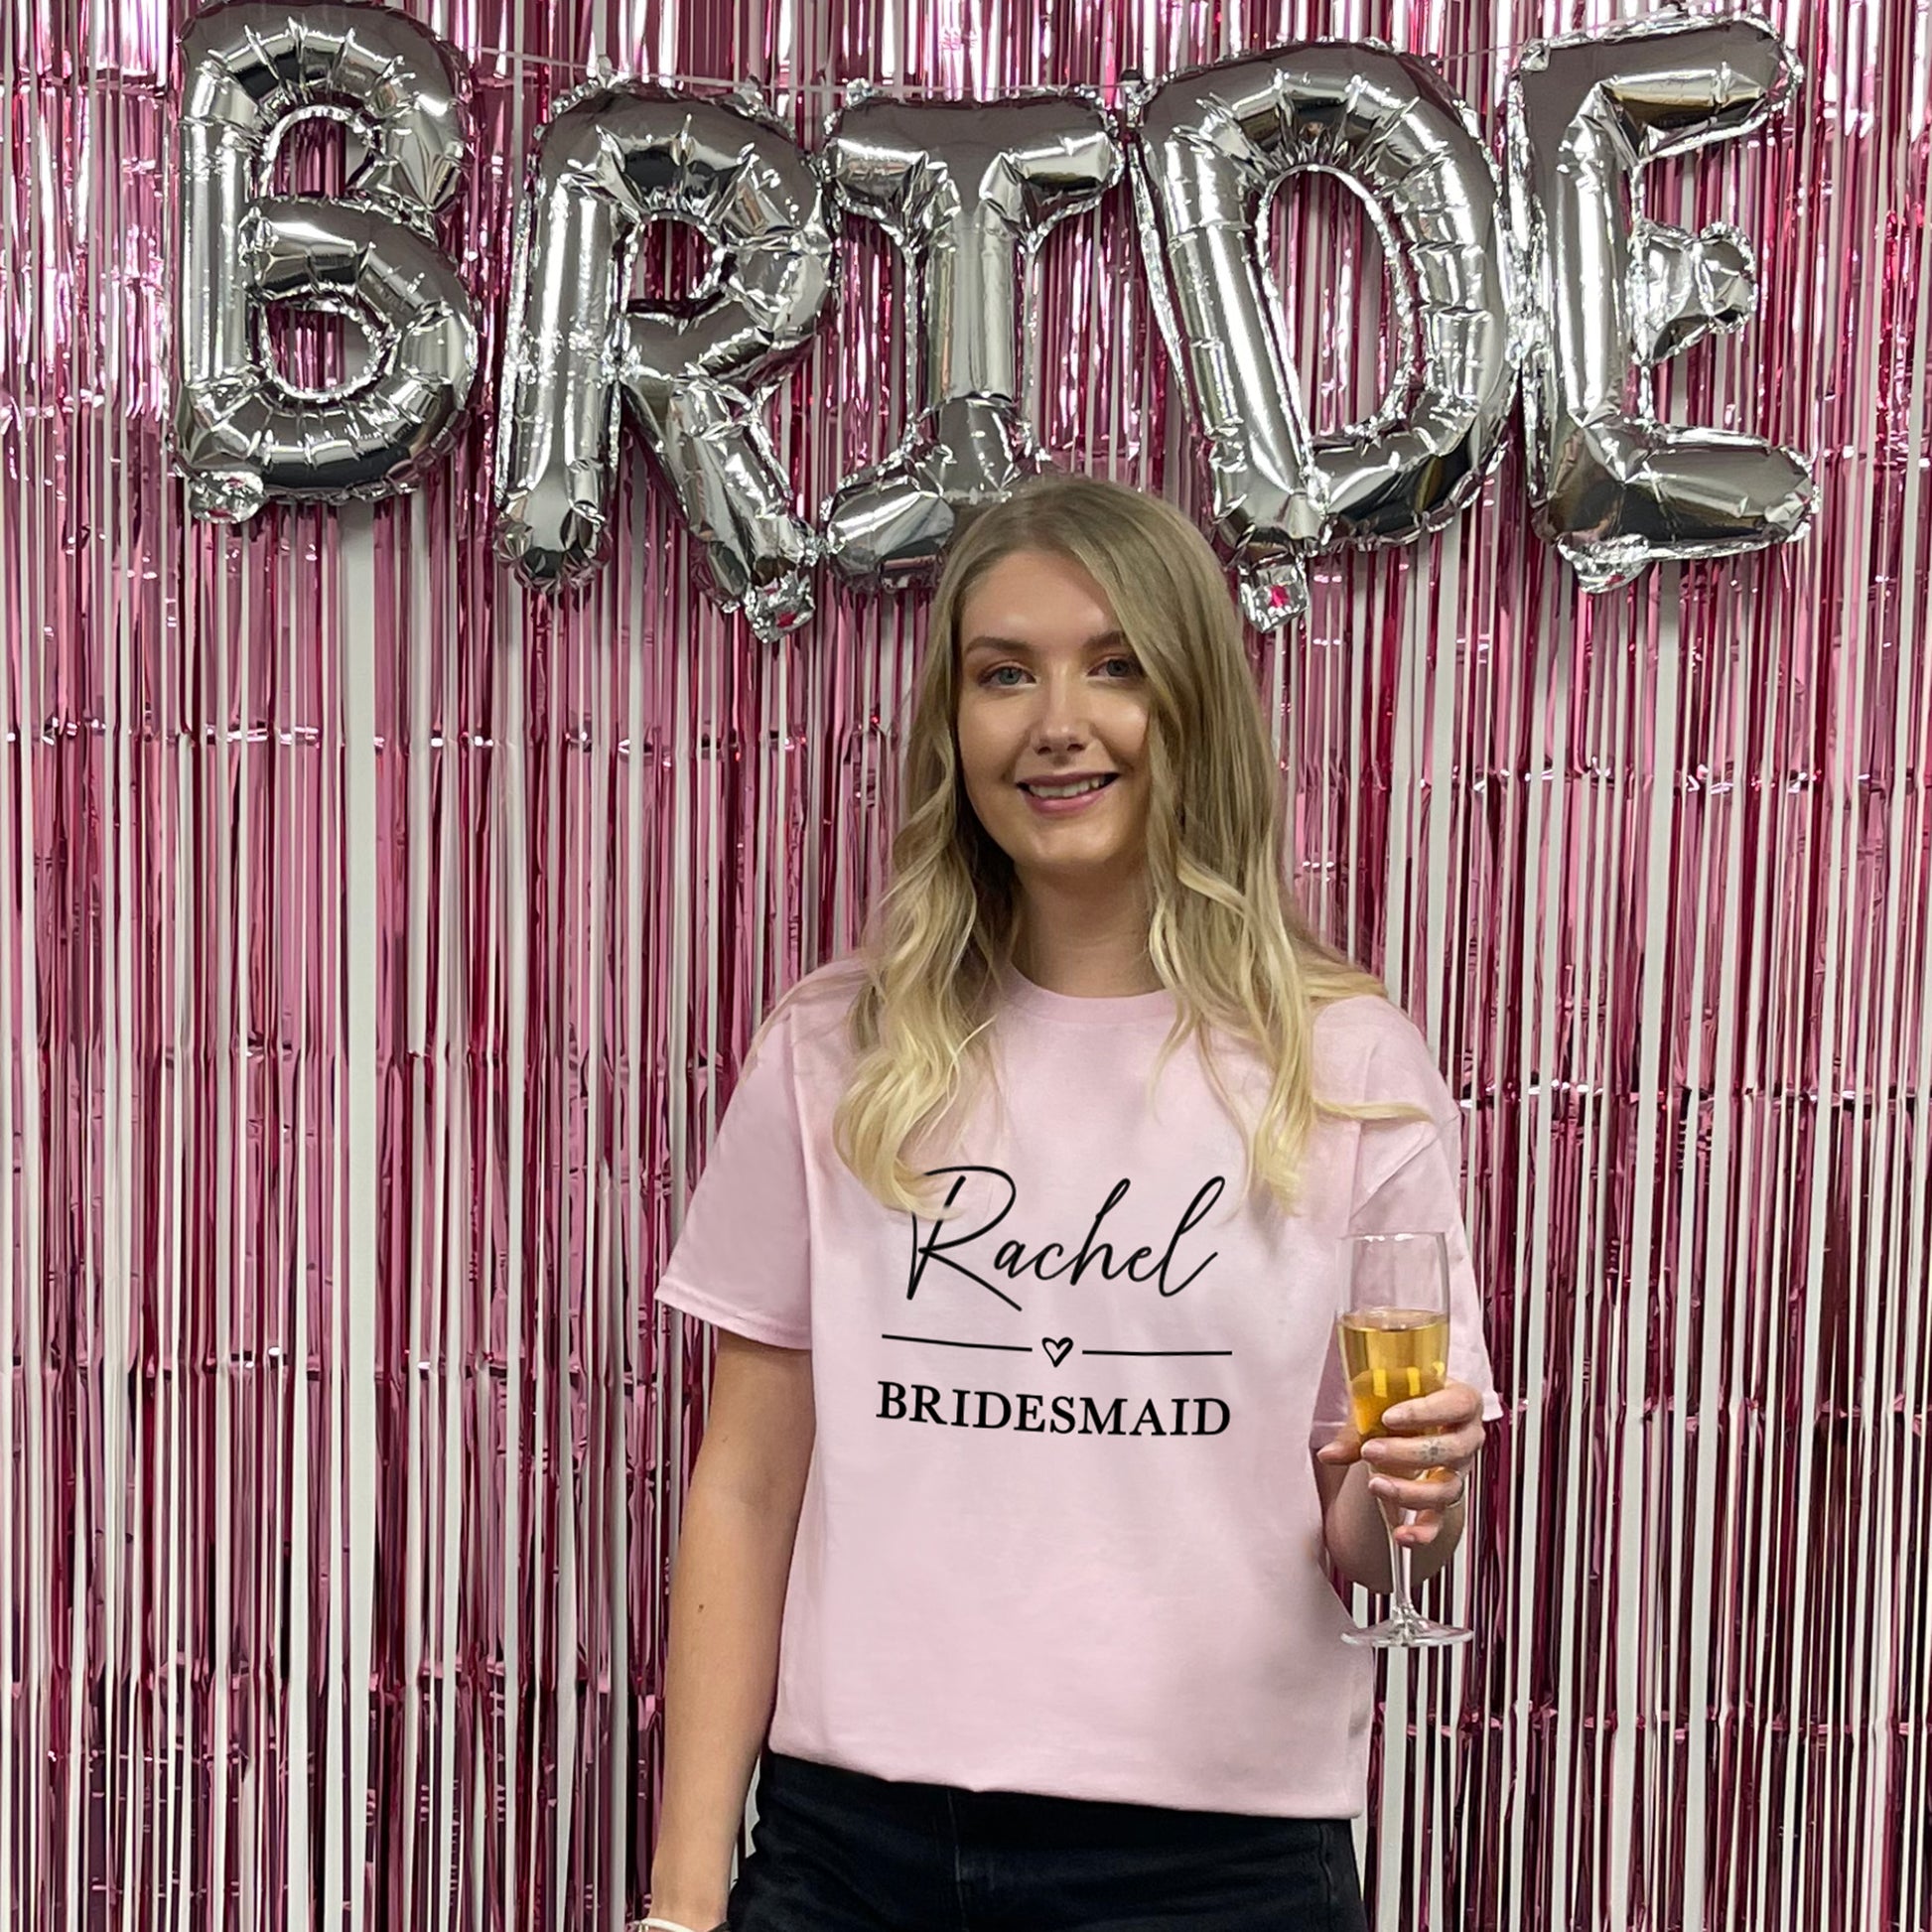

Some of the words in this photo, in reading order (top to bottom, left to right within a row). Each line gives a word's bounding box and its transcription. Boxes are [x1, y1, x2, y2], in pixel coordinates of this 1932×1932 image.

[171, 1, 1819, 641] BRIDE
[906, 1165, 1226, 1312] Rachel
[876, 1380, 1232, 1437] BRIDESMAID
